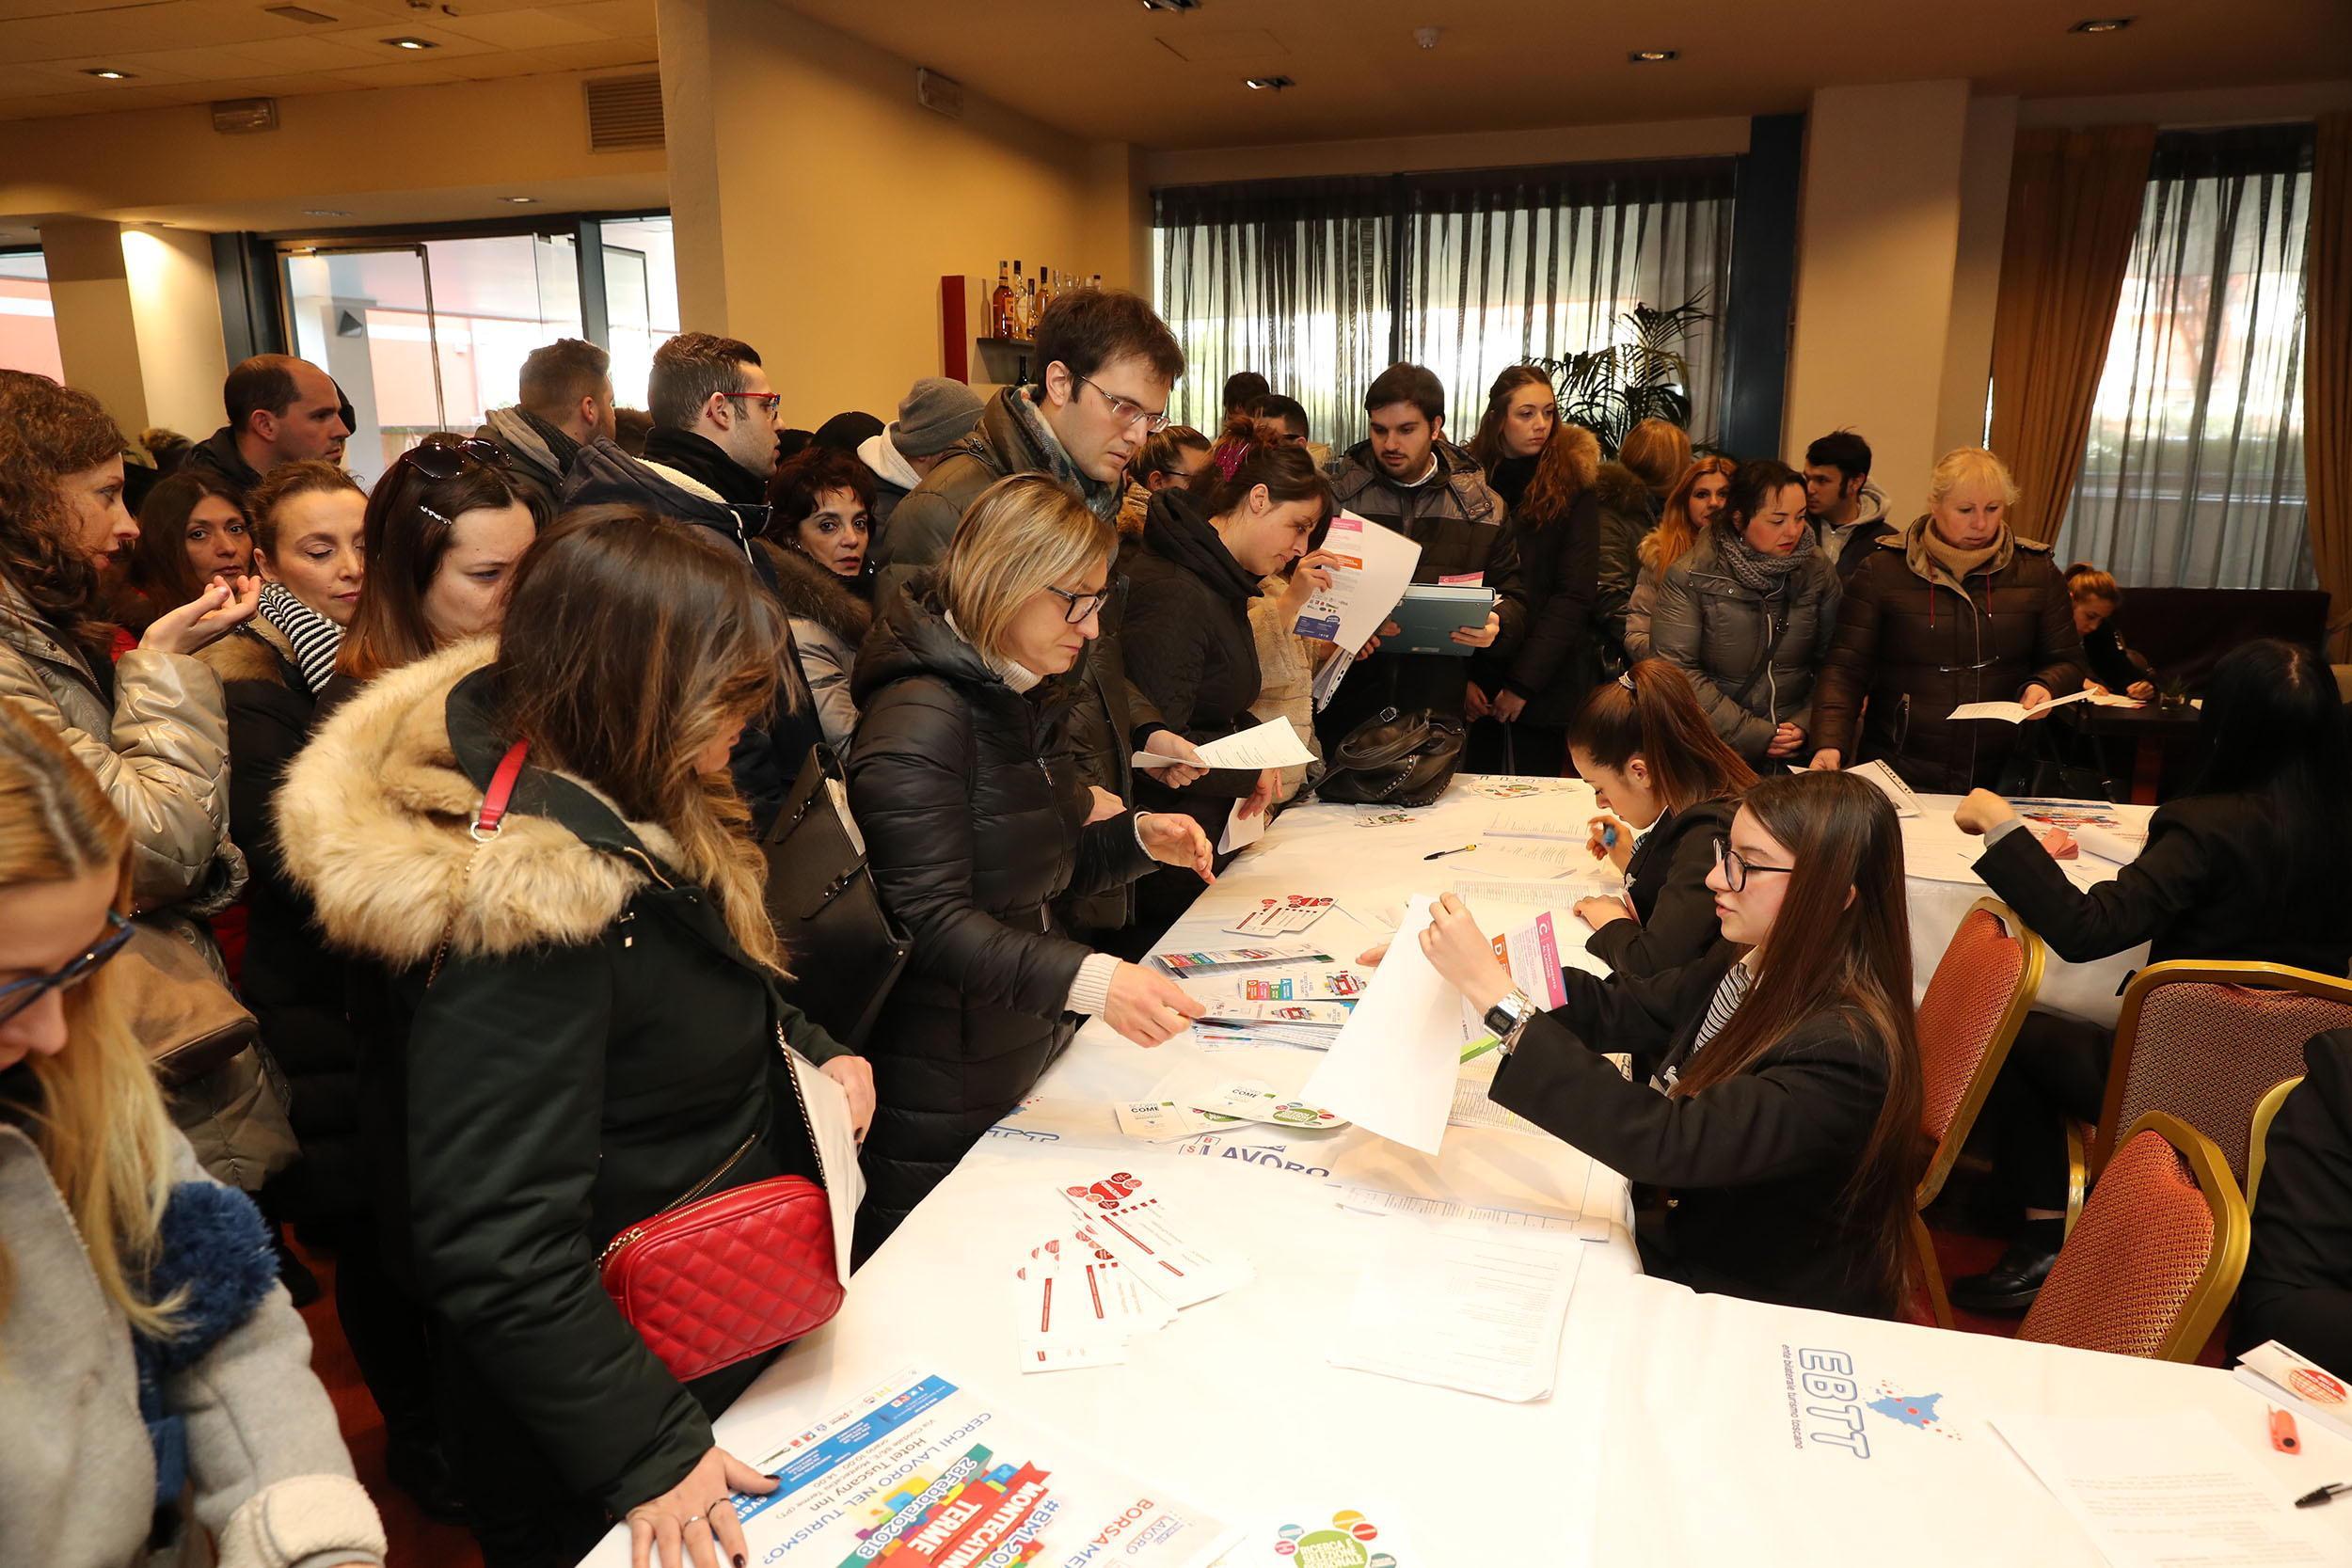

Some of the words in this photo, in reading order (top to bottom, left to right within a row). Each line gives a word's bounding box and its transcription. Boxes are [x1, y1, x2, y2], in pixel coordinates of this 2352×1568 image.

[1538, 923, 1549, 935] C
[1494, 943, 1502, 956] D
[1782, 1344, 1791, 1359] ente
[1784, 1359, 1796, 1390] bilaterale
[1788, 1392, 1799, 1418] turismo
[1799, 1348, 1870, 1459] EBTT
[939, 1413, 992, 1447] CERCHI
[1791, 1419, 1804, 1449] toscano
[893, 1437, 927, 1463] Hotel
[834, 1461, 891, 1497] Tuscany
[878, 1446, 941, 1487] LAVORO
[809, 1495, 835, 1512] Inn
[843, 1486, 878, 1507] NEL
[858, 1457, 977, 1558] 28Febbraio2018
[763, 1509, 845, 1564] TURISMO?
[907, 1500, 982, 1556] TERME
[1063, 1498, 1154, 1568] BORSAME
